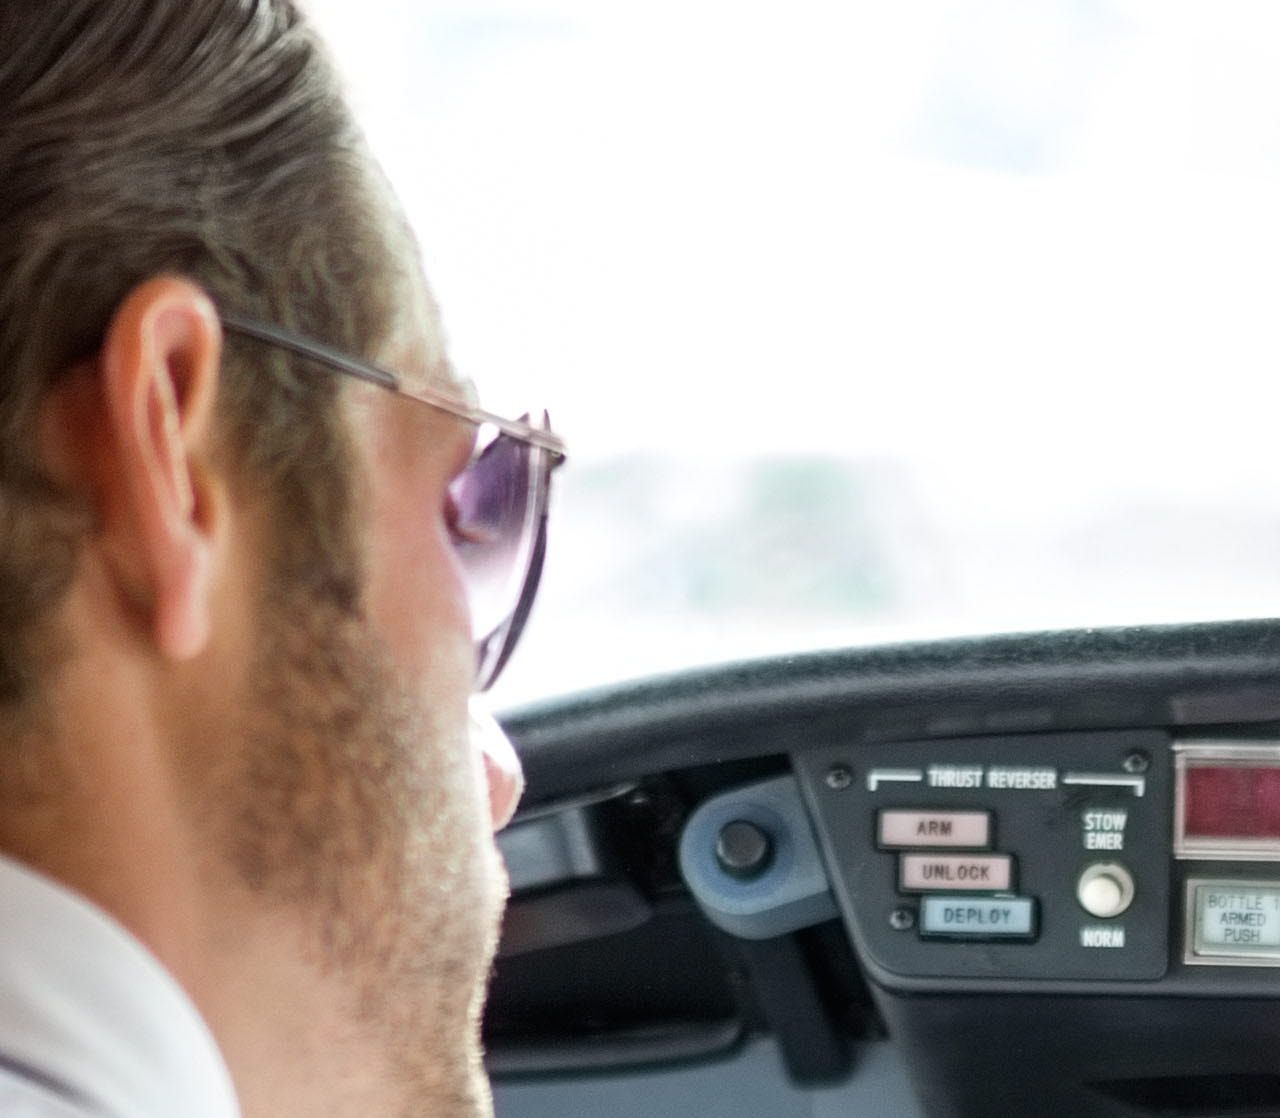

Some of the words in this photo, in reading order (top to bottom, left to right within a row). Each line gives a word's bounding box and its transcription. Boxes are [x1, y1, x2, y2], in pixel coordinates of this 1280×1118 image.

[930, 769, 983, 788] THRUST
[988, 771, 1057, 790] REVERSER
[916, 821, 953, 836] ARM
[1083, 812, 1128, 831] STOW
[1086, 832, 1123, 850] EMER
[922, 864, 990, 881] UNLOCK
[1208, 894, 1264, 911] BOTTLE
[943, 907, 1011, 924] DEPLOY
[1220, 911, 1266, 927] ARMED
[1081, 929, 1125, 947] NORM
[1224, 928, 1261, 943] PUSH
